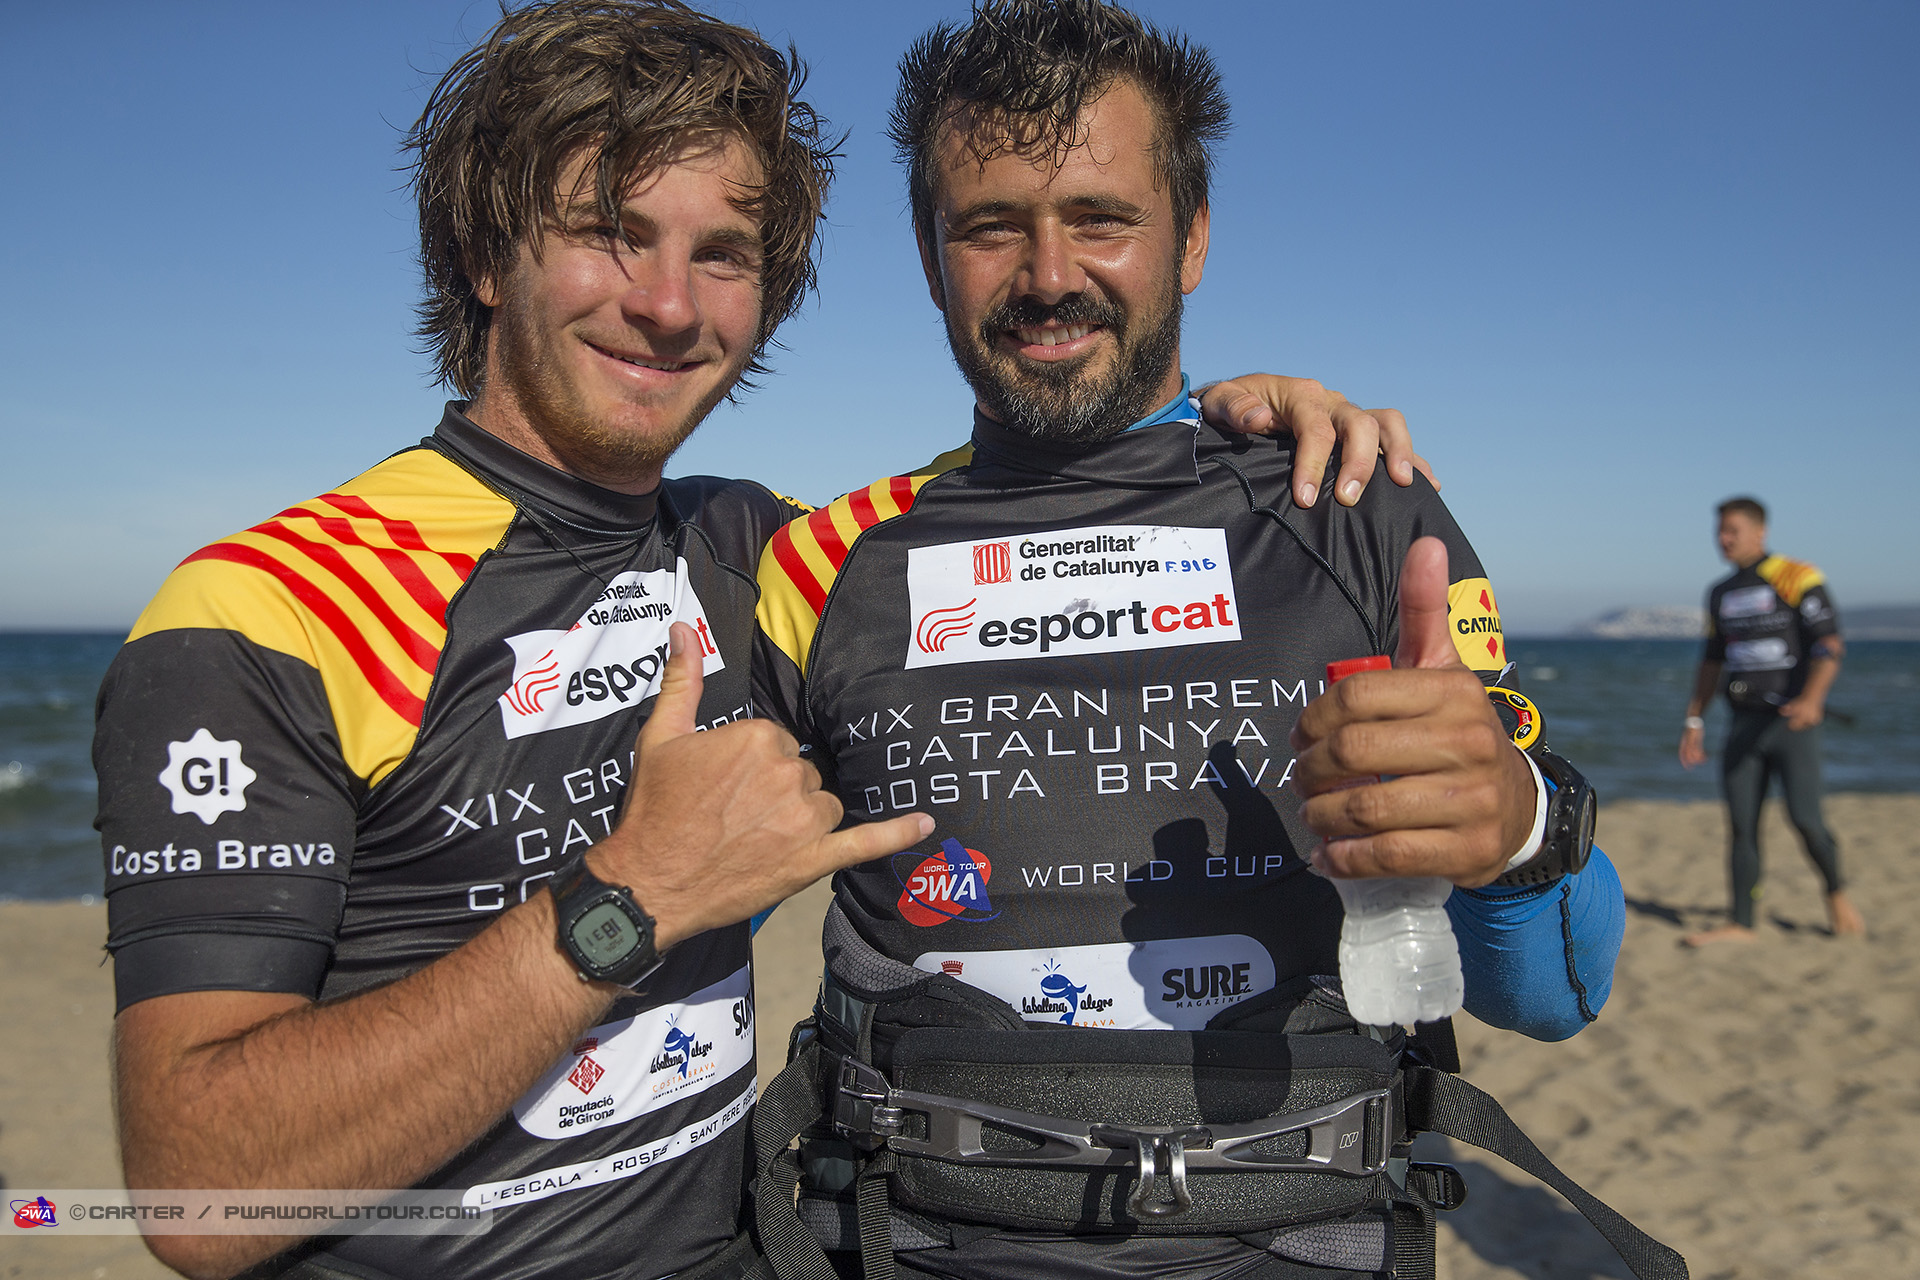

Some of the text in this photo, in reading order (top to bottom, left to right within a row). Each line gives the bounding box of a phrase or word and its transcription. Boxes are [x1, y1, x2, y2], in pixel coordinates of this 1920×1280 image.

[1019, 535, 1136, 559] Generalitat
[1020, 557, 1160, 581] de Catalunya
[587, 608, 609, 626] de
[978, 593, 1234, 653] esportcat
[847, 679, 1326, 745] XIX GRAN PREMI
[886, 718, 1269, 770] CATALUNYA
[181, 757, 230, 796] G!
[864, 768, 1046, 814] COSTA
[439, 783, 545, 837] XIX
[111, 839, 336, 876] Costa Brava
[923, 862, 986, 873] WORLD TOUR
[1021, 855, 1283, 888] WORLD CUP
[908, 872, 977, 902] PWA
[1162, 962, 1250, 1002] SURF
[1080, 993, 1113, 1012] alegre
[1176, 996, 1242, 1009] MAGAZINE
[652, 1062, 716, 1093] COSTA BRAVA
[559, 1095, 614, 1119] Diputació
[559, 1109, 615, 1129] de Girona
[480, 1172, 582, 1205] L'ESCALA
[612, 1144, 669, 1173] ROSES
[690, 1119, 719, 1143] SANT
[722, 1103, 741, 1125] PERE
